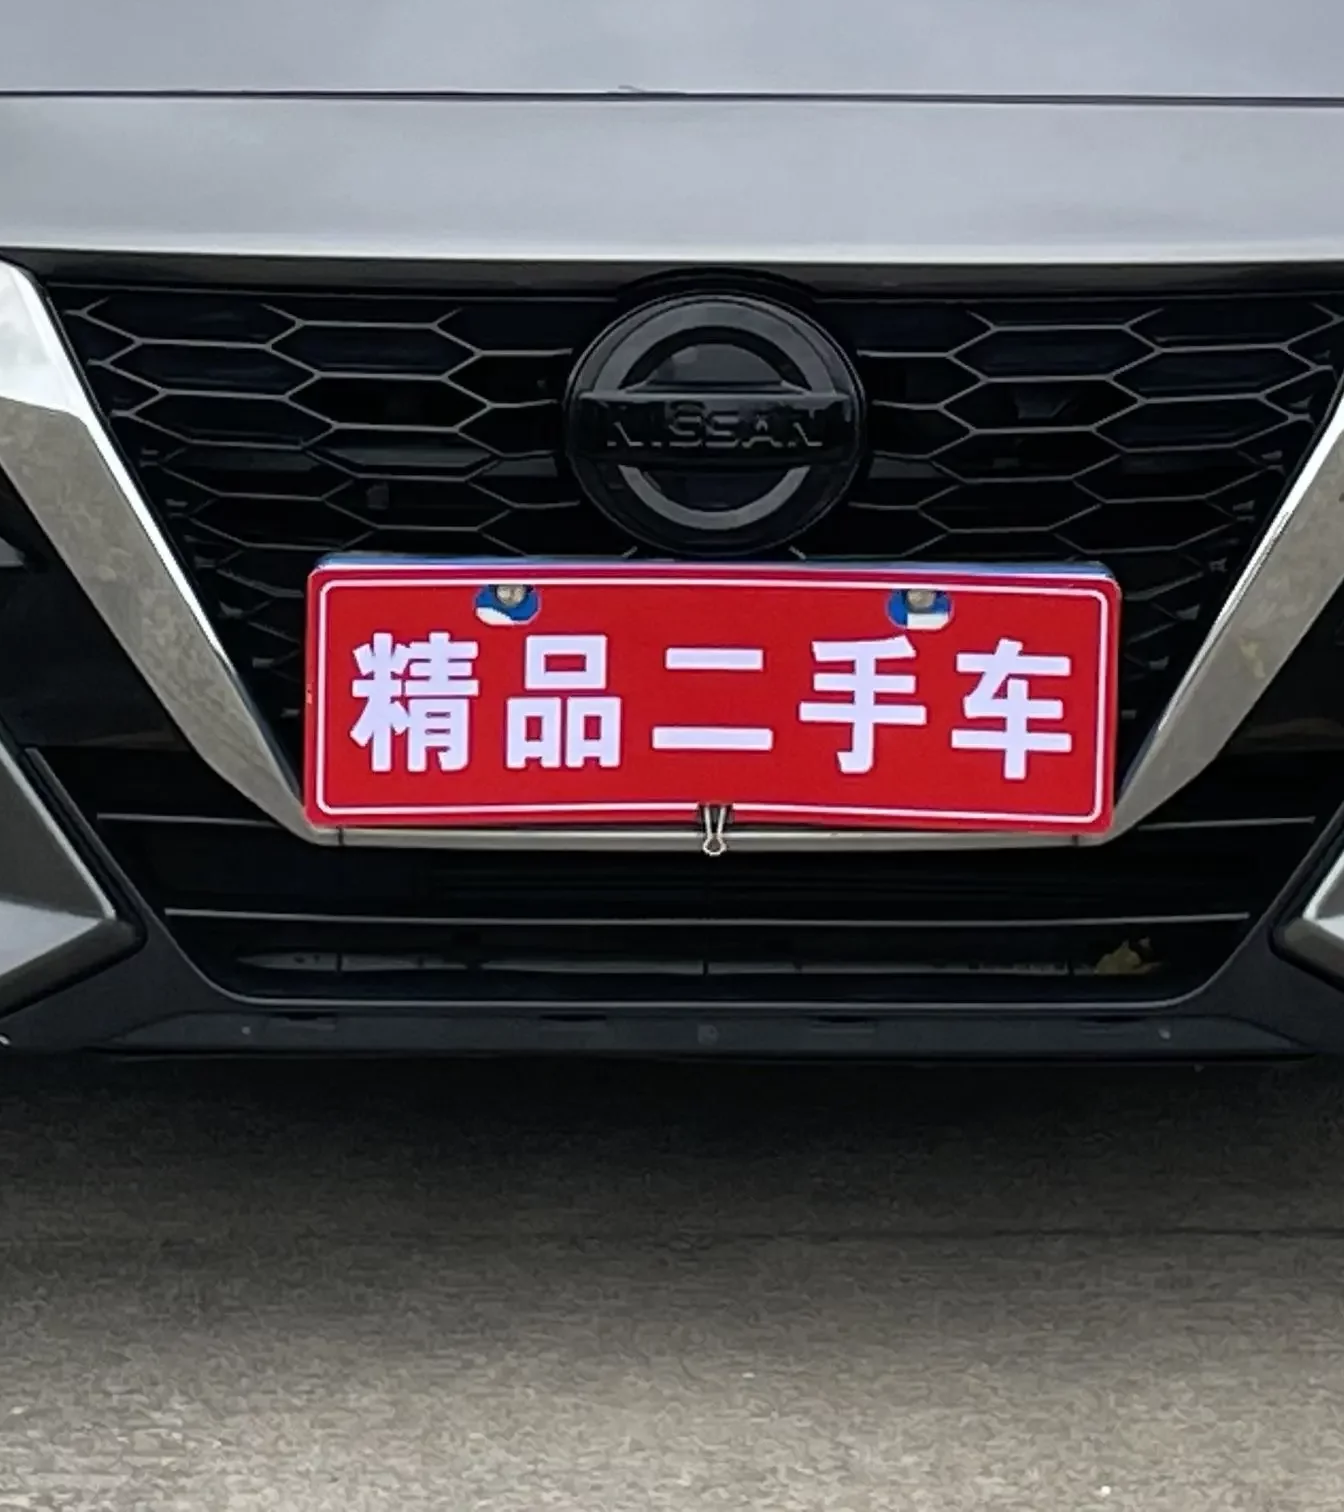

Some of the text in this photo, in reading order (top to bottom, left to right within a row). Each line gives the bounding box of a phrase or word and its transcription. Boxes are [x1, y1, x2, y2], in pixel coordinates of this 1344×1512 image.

[606, 402, 823, 447] NISSAN
[350, 632, 1072, 779] 精品二手车
